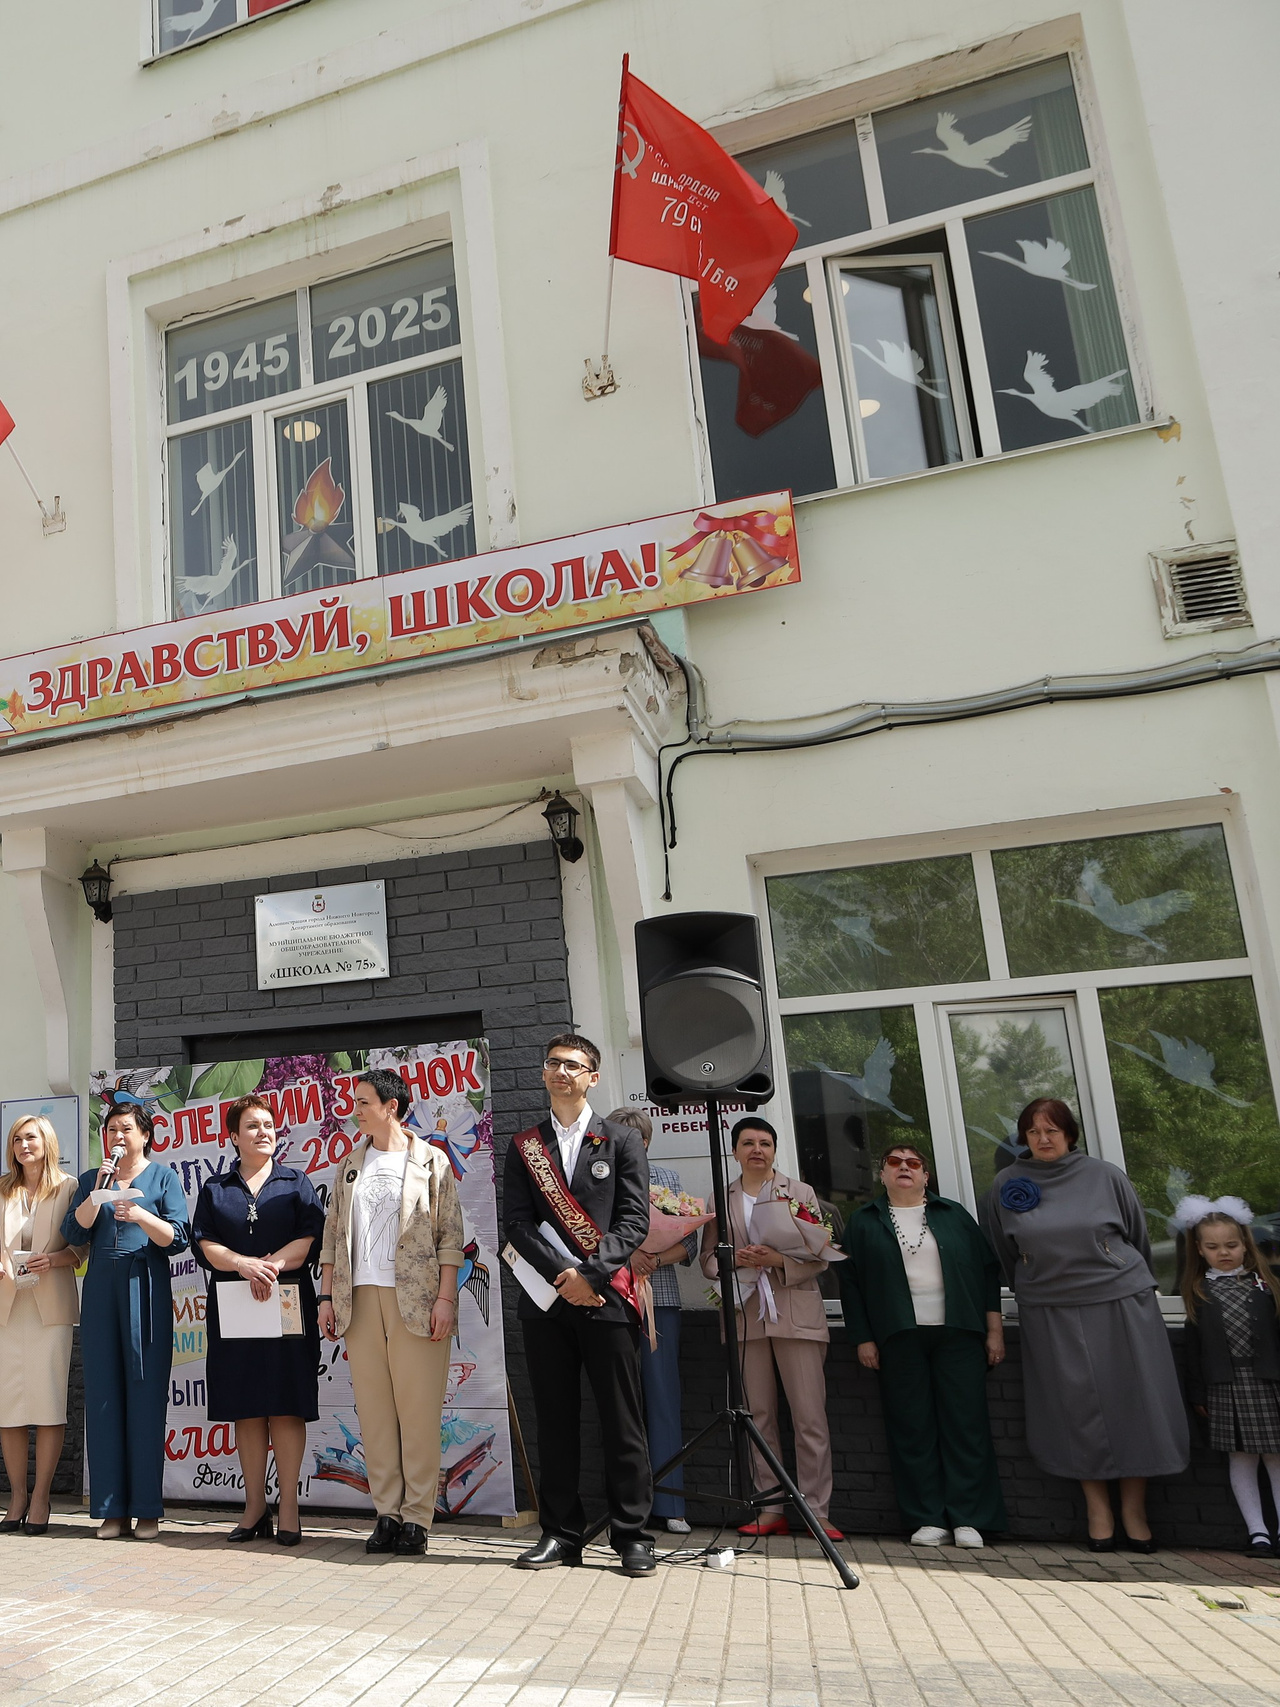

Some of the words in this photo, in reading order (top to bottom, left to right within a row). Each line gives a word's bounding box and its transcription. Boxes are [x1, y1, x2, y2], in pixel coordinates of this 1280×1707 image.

[661, 196, 688, 226] 79
[174, 333, 290, 400] 1945
[328, 286, 452, 360] 2025
[26, 597, 369, 716] ЗДРАВСТВУЙ,
[389, 542, 659, 638] ШКОЛА!
[269, 936, 328, 947] МУНИЦИПАЛЬНОЕ
[329, 930, 373, 940] БЮДЖЕТНОЕ
[280, 939, 361, 952] ОБЩЕОБРАЗОВАТЕЛЬНОЕ
[298, 948, 344, 957] УЧРЕЖДЕНИЕ
[270, 964, 332, 979] «ШКОЛА
[336, 961, 352, 973] №
[356, 958, 376, 971] 75»
[334, 1052, 481, 1117] ЗНОК
[662, 1119, 730, 1134] РЕБЕНА
[529, 1156, 576, 1221] Выпускник
[564, 1213, 600, 1250] 2025
[172, 1331, 203, 1354] АМ!
